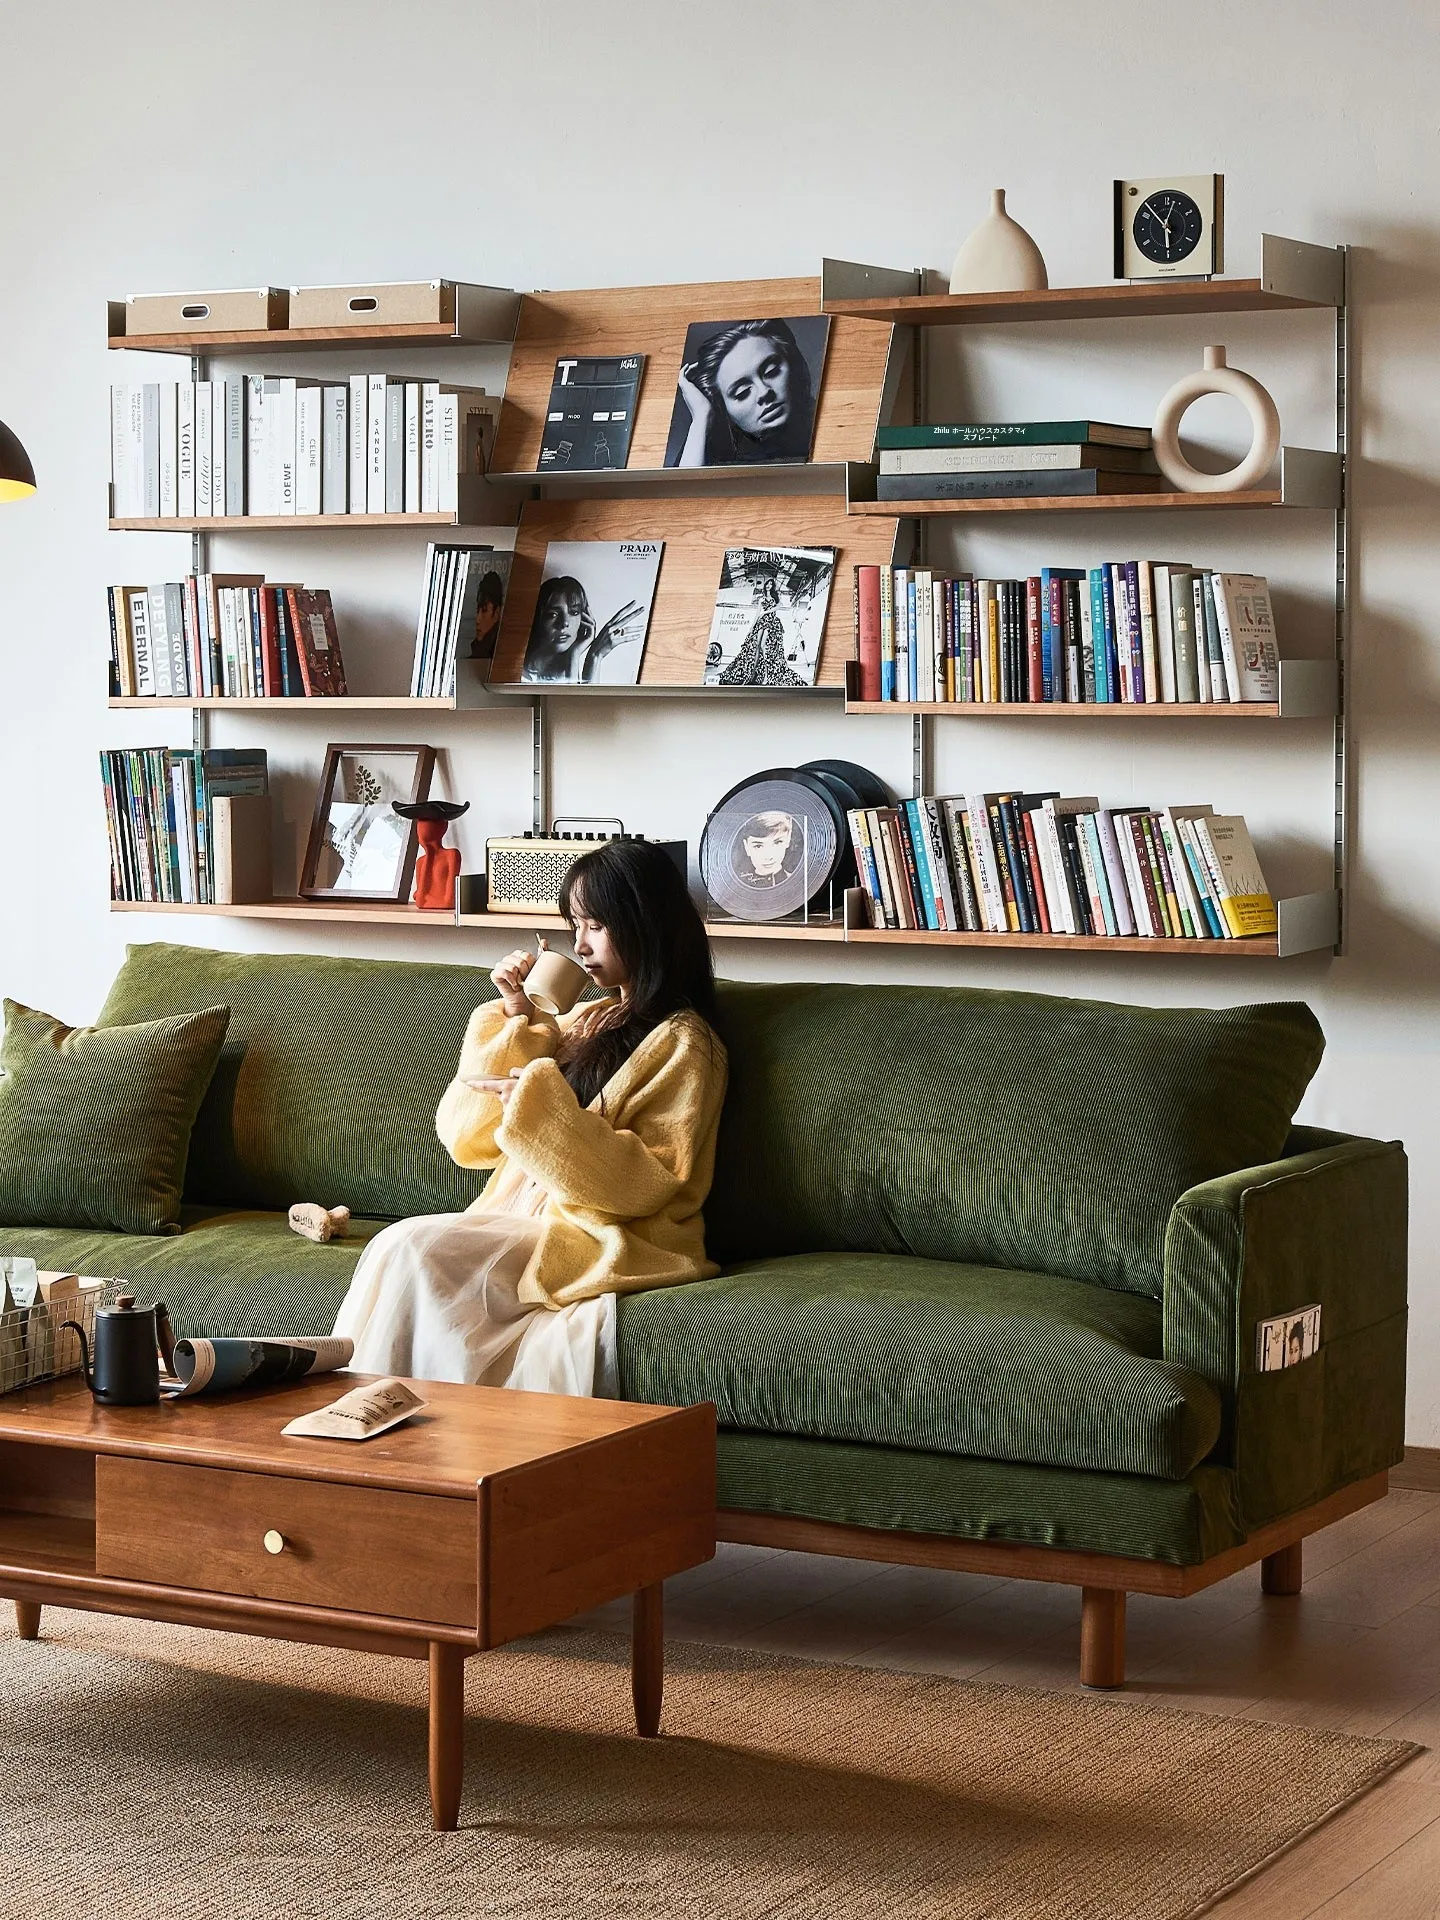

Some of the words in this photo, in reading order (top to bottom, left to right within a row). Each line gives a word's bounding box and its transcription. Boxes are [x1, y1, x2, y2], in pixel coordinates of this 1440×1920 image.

[557, 360, 578, 386] T
[231, 384, 239, 416] SPECIAL
[469, 406, 490, 415] STYLE
[231, 419, 239, 440] ISSUE
[408, 415, 417, 457] VOGUE
[444, 407, 453, 446] STYLE
[952, 427, 1027, 435] ホールハウスカスタマイ
[181, 422, 191, 480] VOGUE
[309, 438, 317, 468] CELINE
[163, 462, 171, 502] Picasso
[197, 454, 210, 505] Cartier
[214, 462, 222, 504] VOGUE
[283, 462, 292, 504] LOEWE
[469, 559, 508, 575] FIGARO
[619, 544, 657, 553] PRADA
[133, 600, 150, 688] ETERNAL
[171, 632, 184, 693] FACADE
